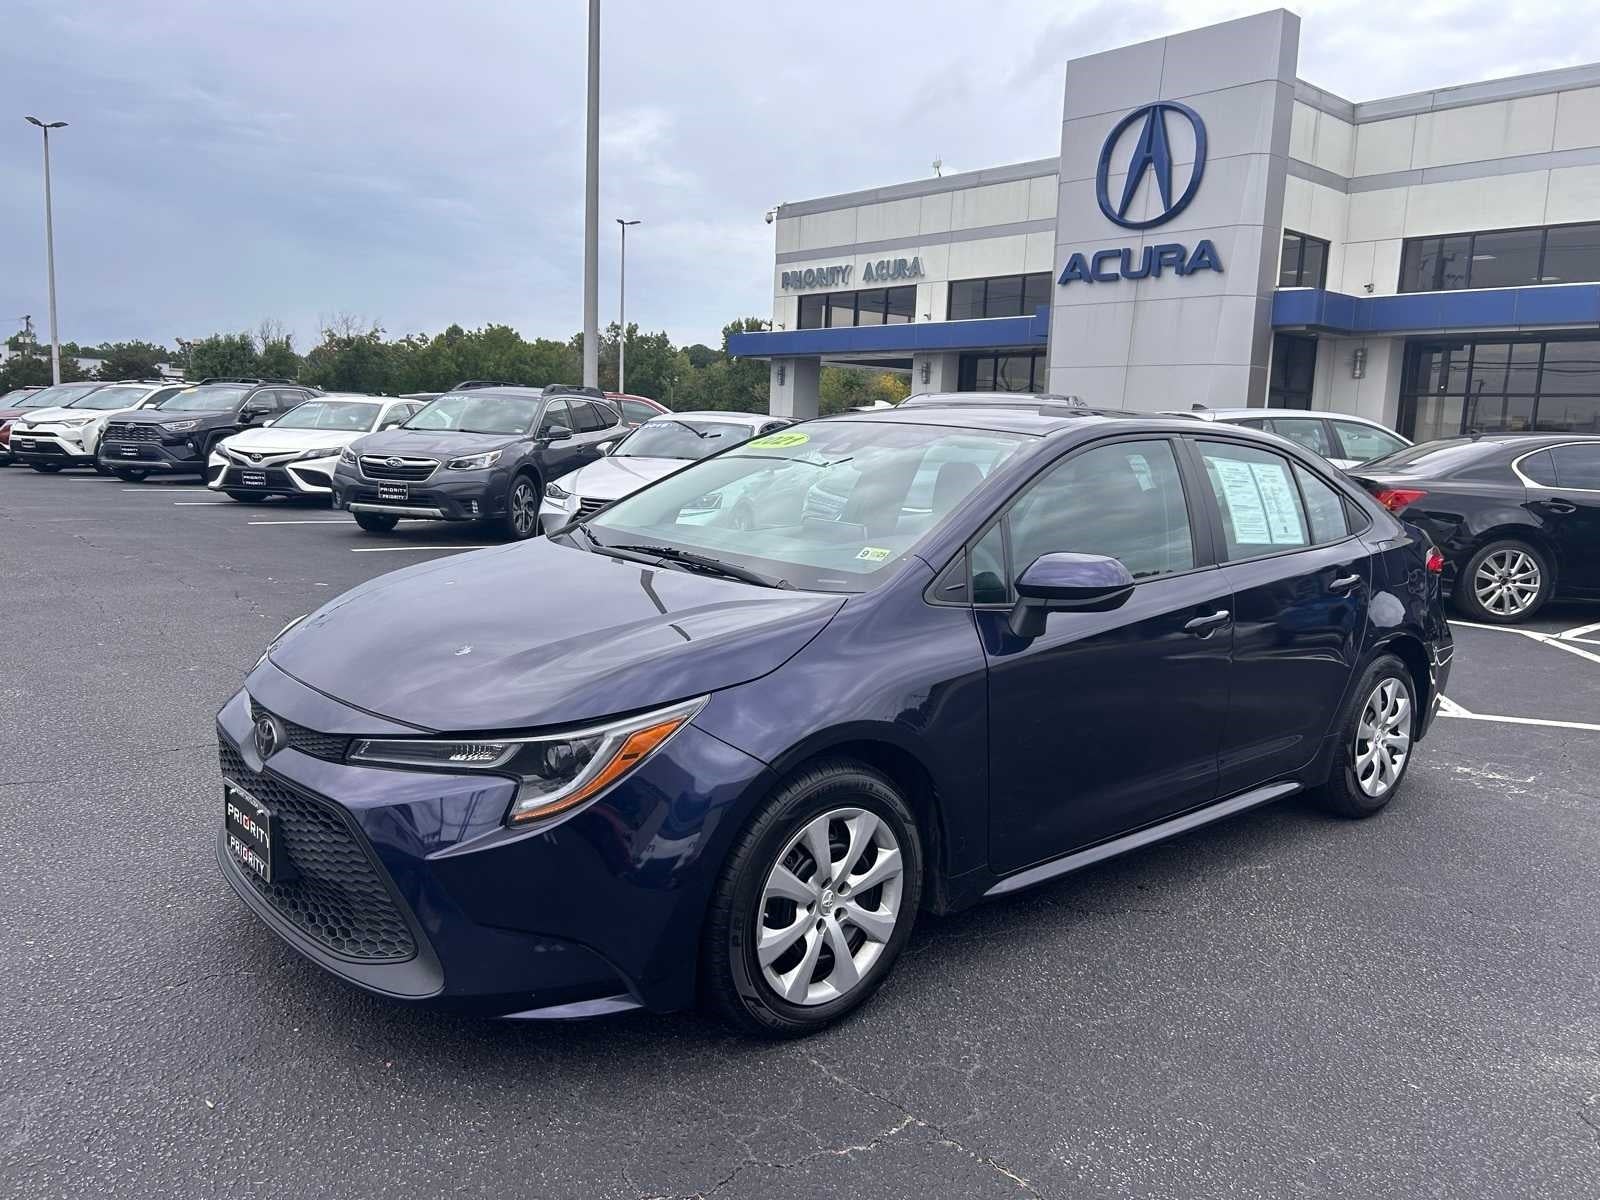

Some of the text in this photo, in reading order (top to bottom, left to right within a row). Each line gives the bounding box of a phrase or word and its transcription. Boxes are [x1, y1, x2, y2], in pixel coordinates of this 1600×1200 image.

[781, 256, 925, 291] PRIORITY ACURA
[1057, 239, 1225, 285] ACURA
[227, 802, 270, 849] PRIORITY
[230, 835, 265, 876] PRIORITY
